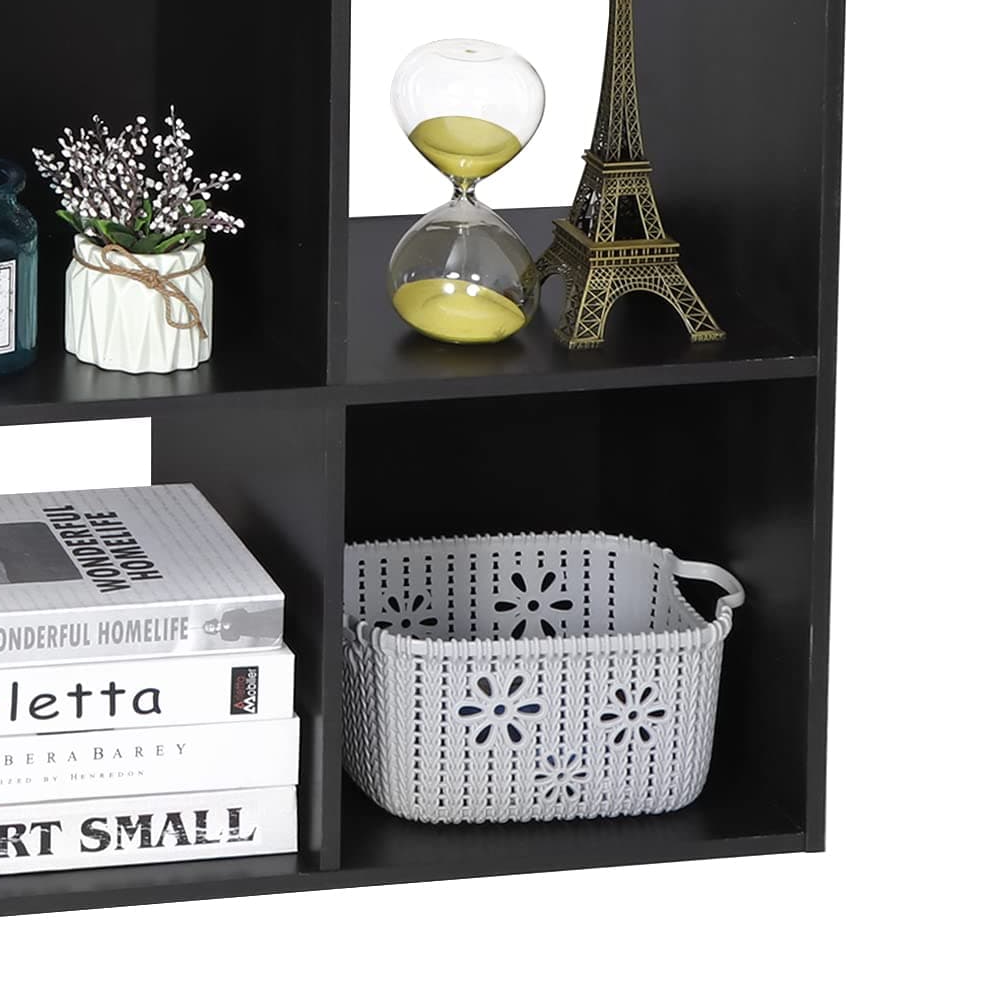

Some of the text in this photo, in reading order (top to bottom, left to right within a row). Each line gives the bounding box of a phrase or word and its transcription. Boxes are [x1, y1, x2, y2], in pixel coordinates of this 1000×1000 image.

[43, 505, 131, 593] WONDERFUL
[84, 512, 163, 580] HOMELIFE
[98, 616, 190, 645] HOMELIFE
[43, 775, 59, 784] BY
[79, 807, 258, 853] SMALL
